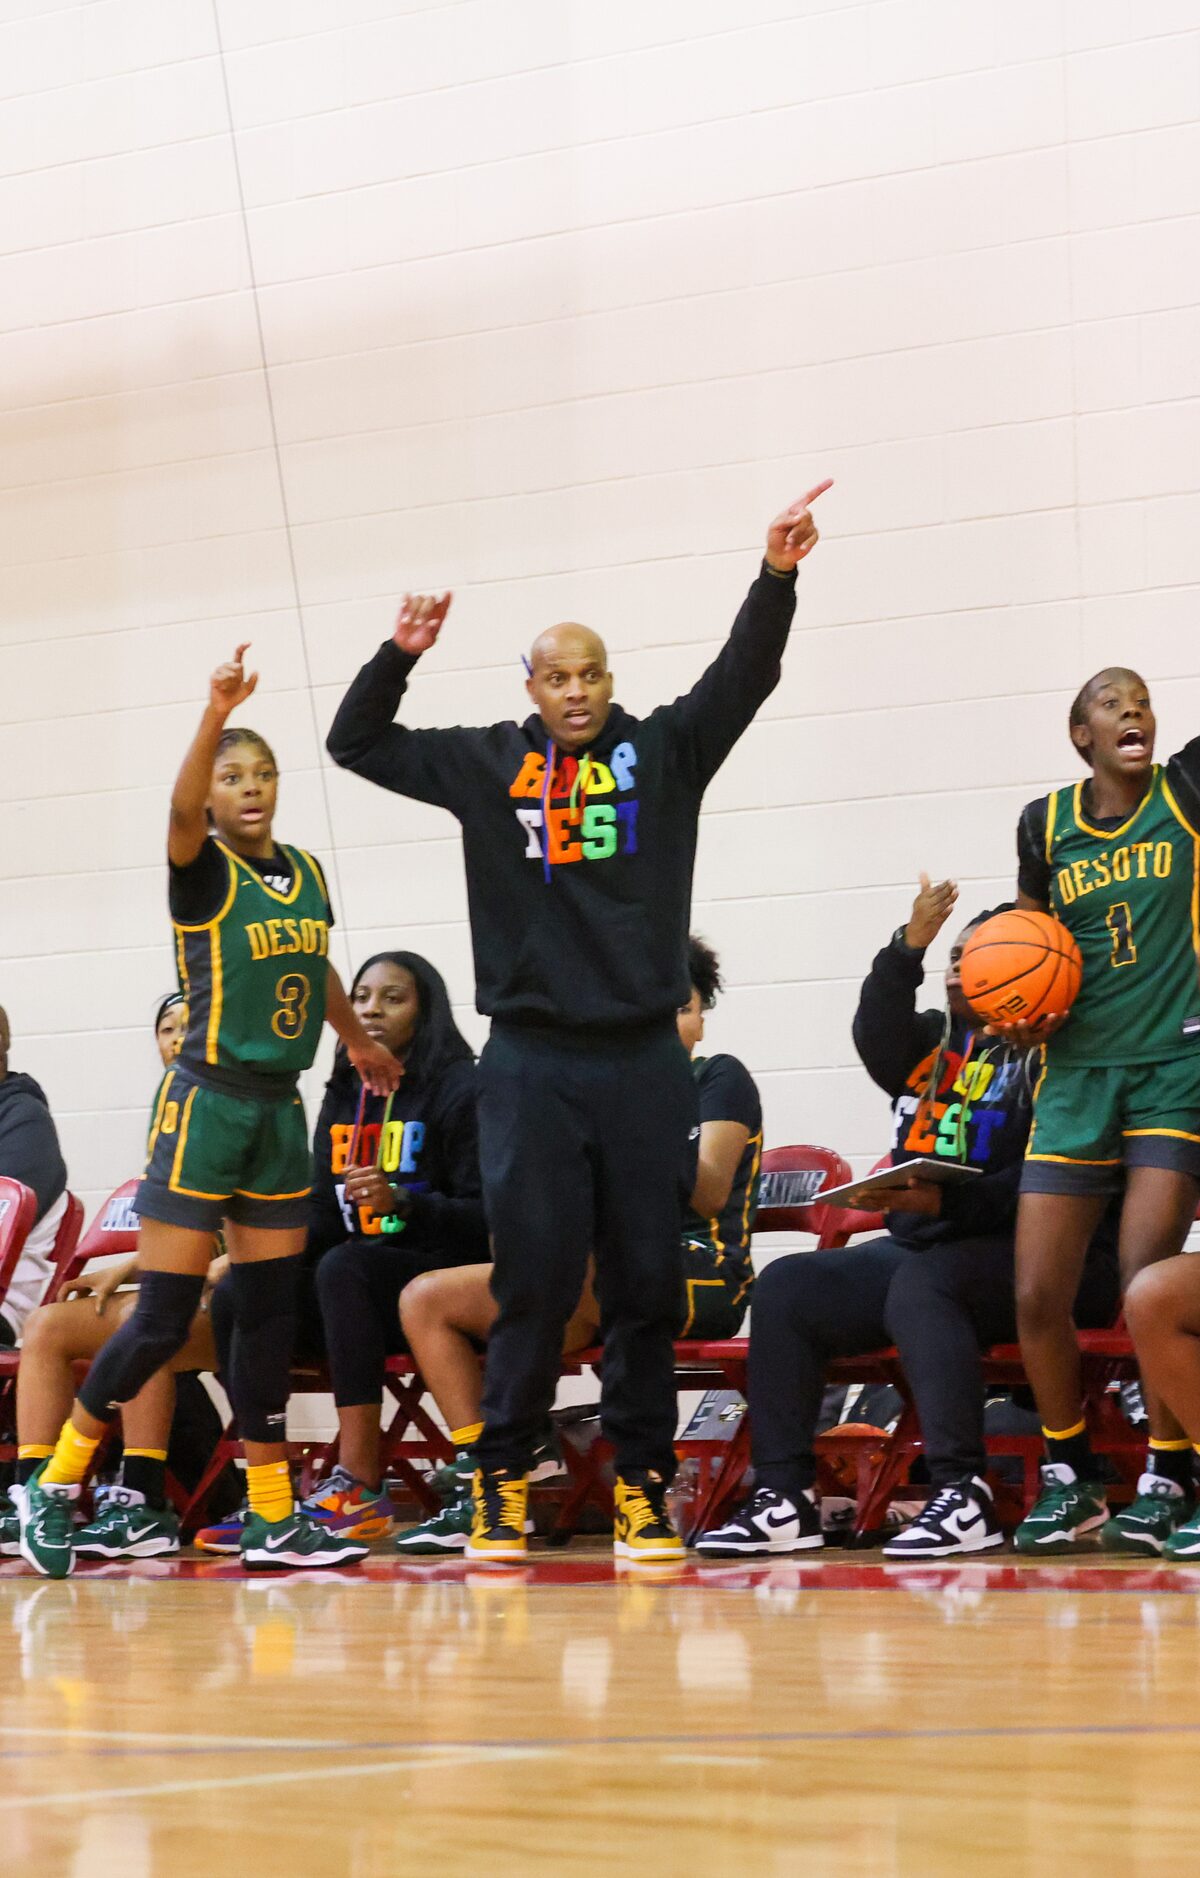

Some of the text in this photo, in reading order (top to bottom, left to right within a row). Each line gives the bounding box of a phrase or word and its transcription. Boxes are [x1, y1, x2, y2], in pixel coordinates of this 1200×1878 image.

[1058, 841, 1172, 905] DESOTO
[245, 918, 328, 960] DESOT
[1105, 902, 1137, 968] 1
[271, 973, 311, 1040] 3
[892, 1095, 1007, 1161] FEST
